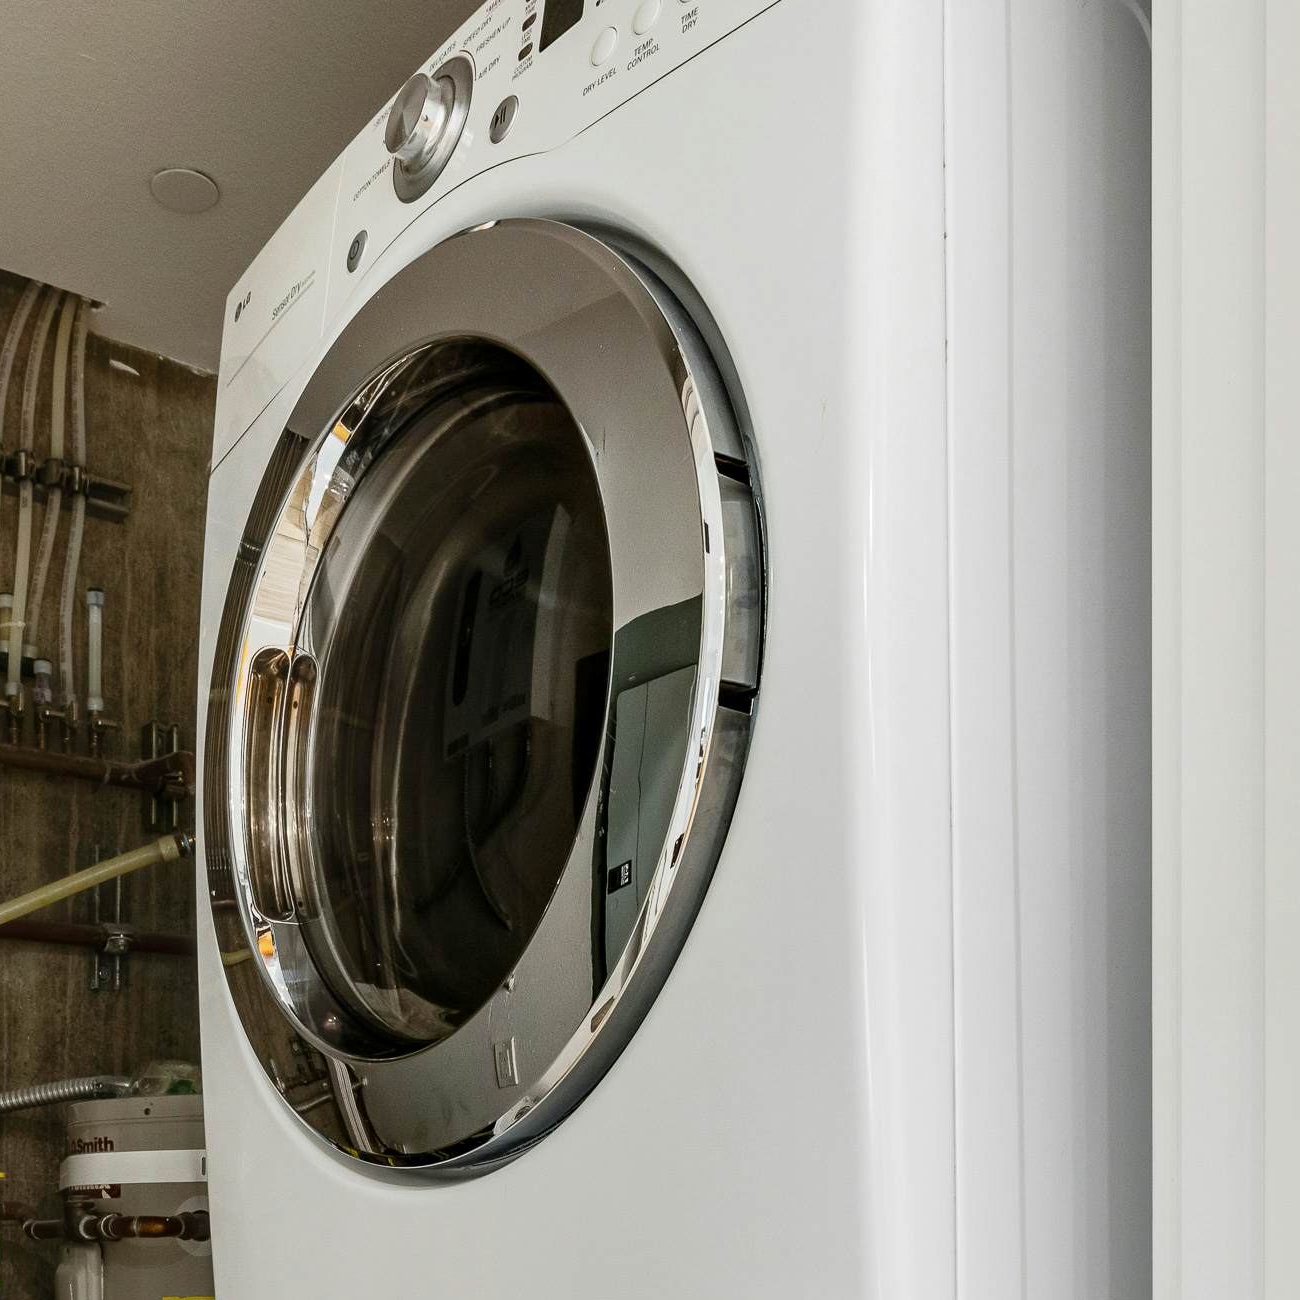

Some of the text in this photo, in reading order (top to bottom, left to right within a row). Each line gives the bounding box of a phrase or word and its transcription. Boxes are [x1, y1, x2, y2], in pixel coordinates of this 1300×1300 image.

[481, 16, 492, 31] DRY
[681, 7, 699, 24] TIME
[682, 18, 698, 34] DRY
[476, 16, 511, 54] FRESHEN UP
[478, 55, 501, 80] AIR DRY
[627, 43, 661, 71] CONTROL
[582, 67, 617, 96] DRY LEVEL
